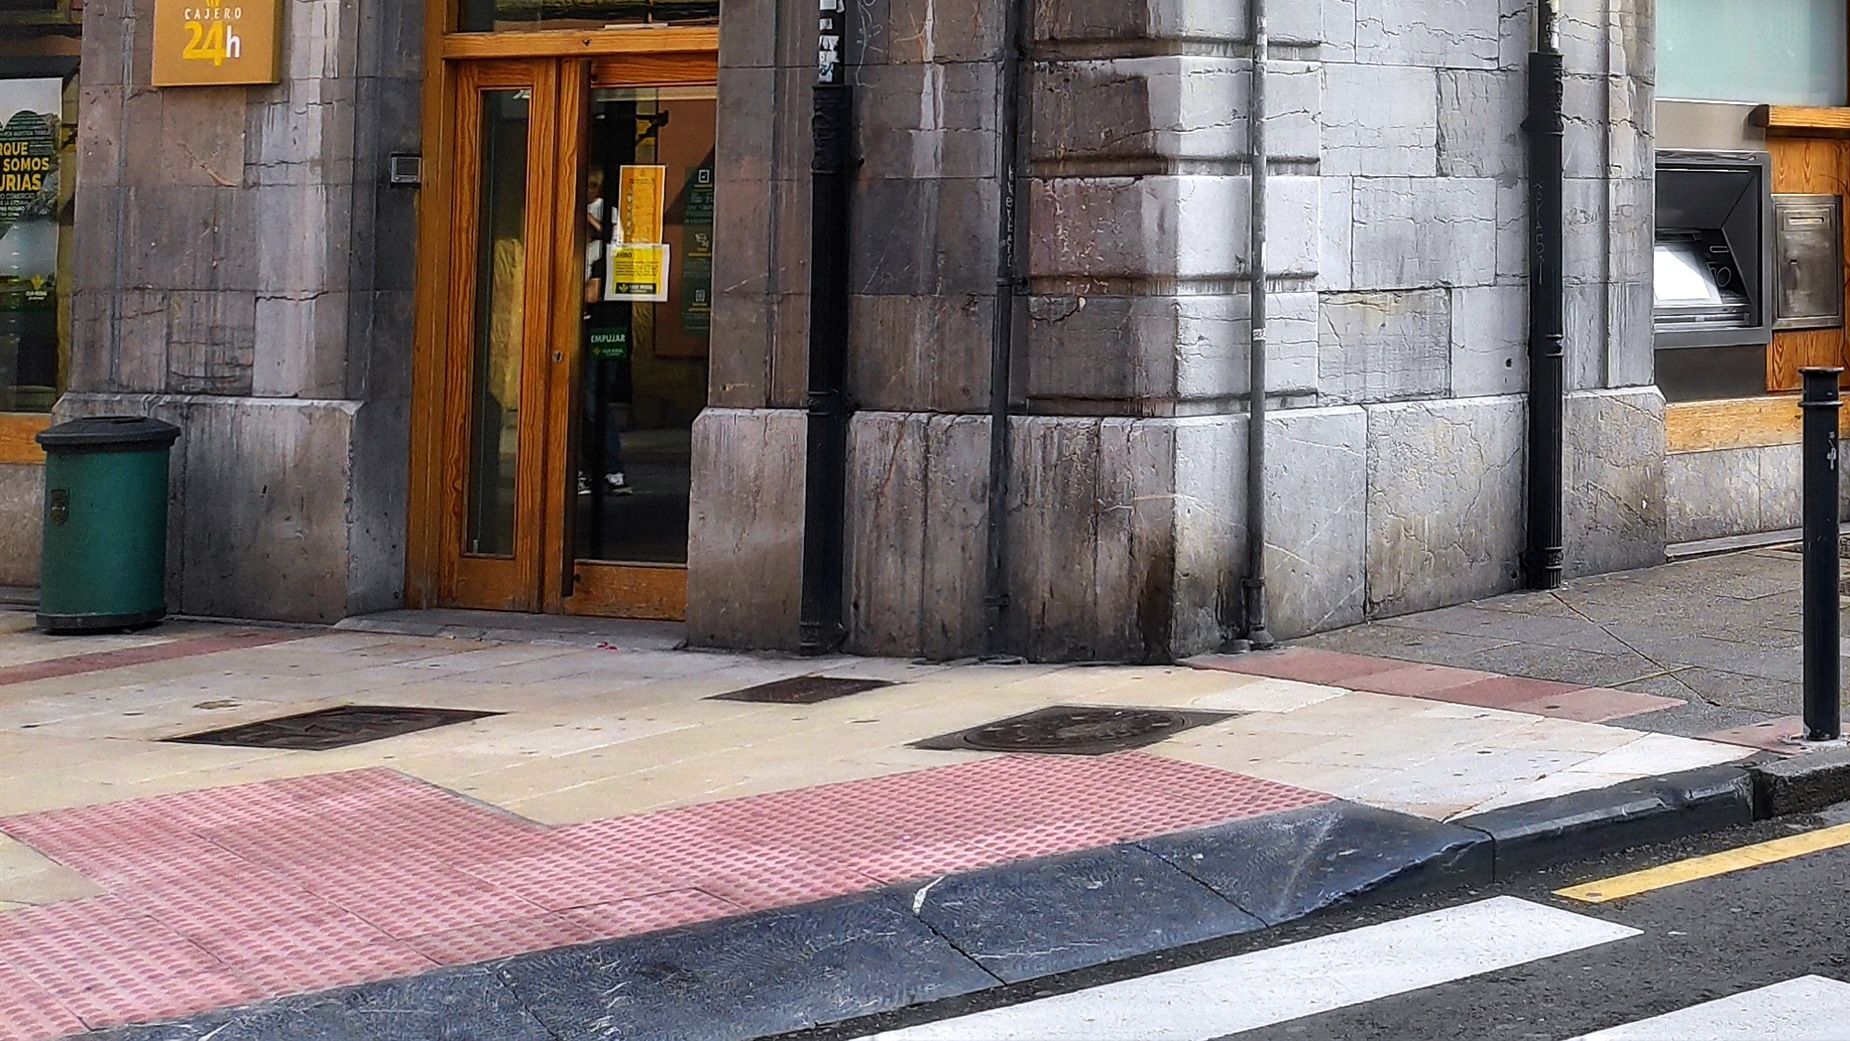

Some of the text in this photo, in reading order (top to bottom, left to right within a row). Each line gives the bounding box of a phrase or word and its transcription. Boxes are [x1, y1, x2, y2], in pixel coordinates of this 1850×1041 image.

[184, 6, 242, 20] CAJERO
[182, 20, 241, 66] 24h
[3, 157, 50, 172] SOMOS
